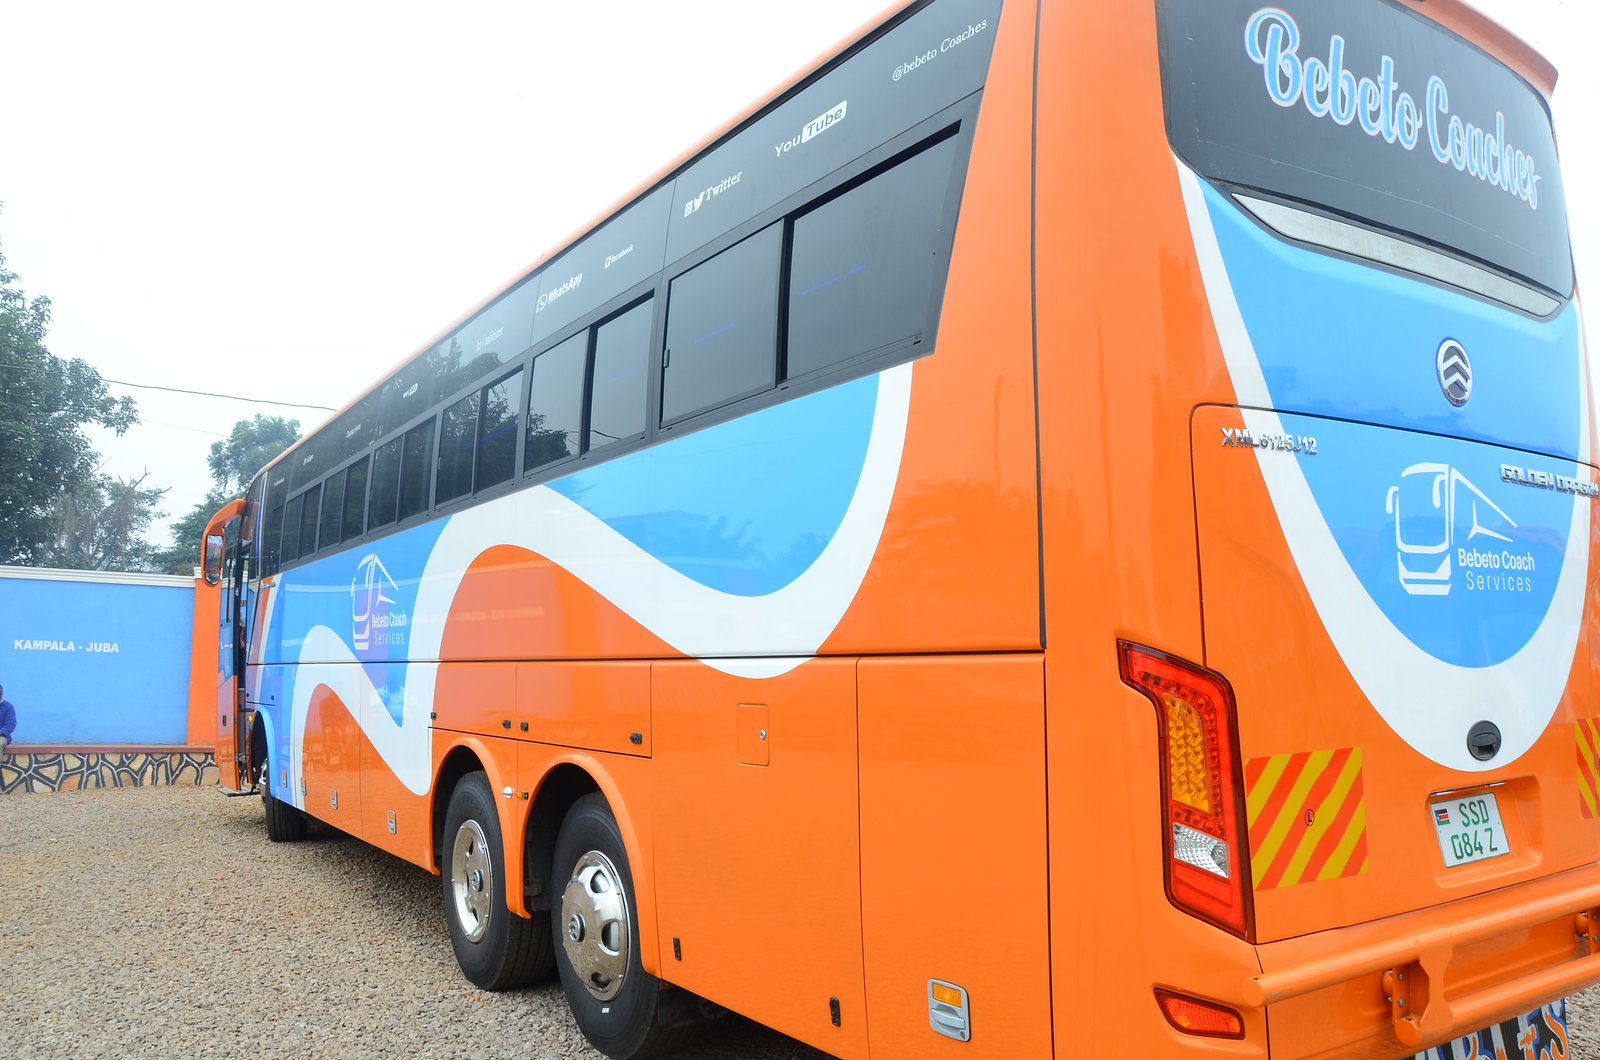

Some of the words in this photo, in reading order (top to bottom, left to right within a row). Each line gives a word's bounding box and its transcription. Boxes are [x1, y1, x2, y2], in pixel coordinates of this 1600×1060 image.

[892, 47, 938, 82] @bebeto
[940, 18, 988, 53] Coaches
[1244, 7, 1423, 150] Bebeto
[1426, 75, 1542, 210] Coaches
[705, 171, 743, 201] Twitter
[547, 272, 583, 304] WhatsApp
[1500, 463, 1555, 491] GOLDEN
[1458, 547, 1500, 569] Bebeto
[1501, 550, 1535, 571] Coach
[1466, 570, 1532, 592] Services
[371, 612, 389, 628] Bebeto
[389, 610, 407, 628] Coach
[13, 639, 76, 652] KAMPALA
[86, 642, 120, 653] JUBA
[374, 630, 405, 646] Services
[1458, 799, 1489, 827] SSD
[1484, 827, 1498, 852] Z
